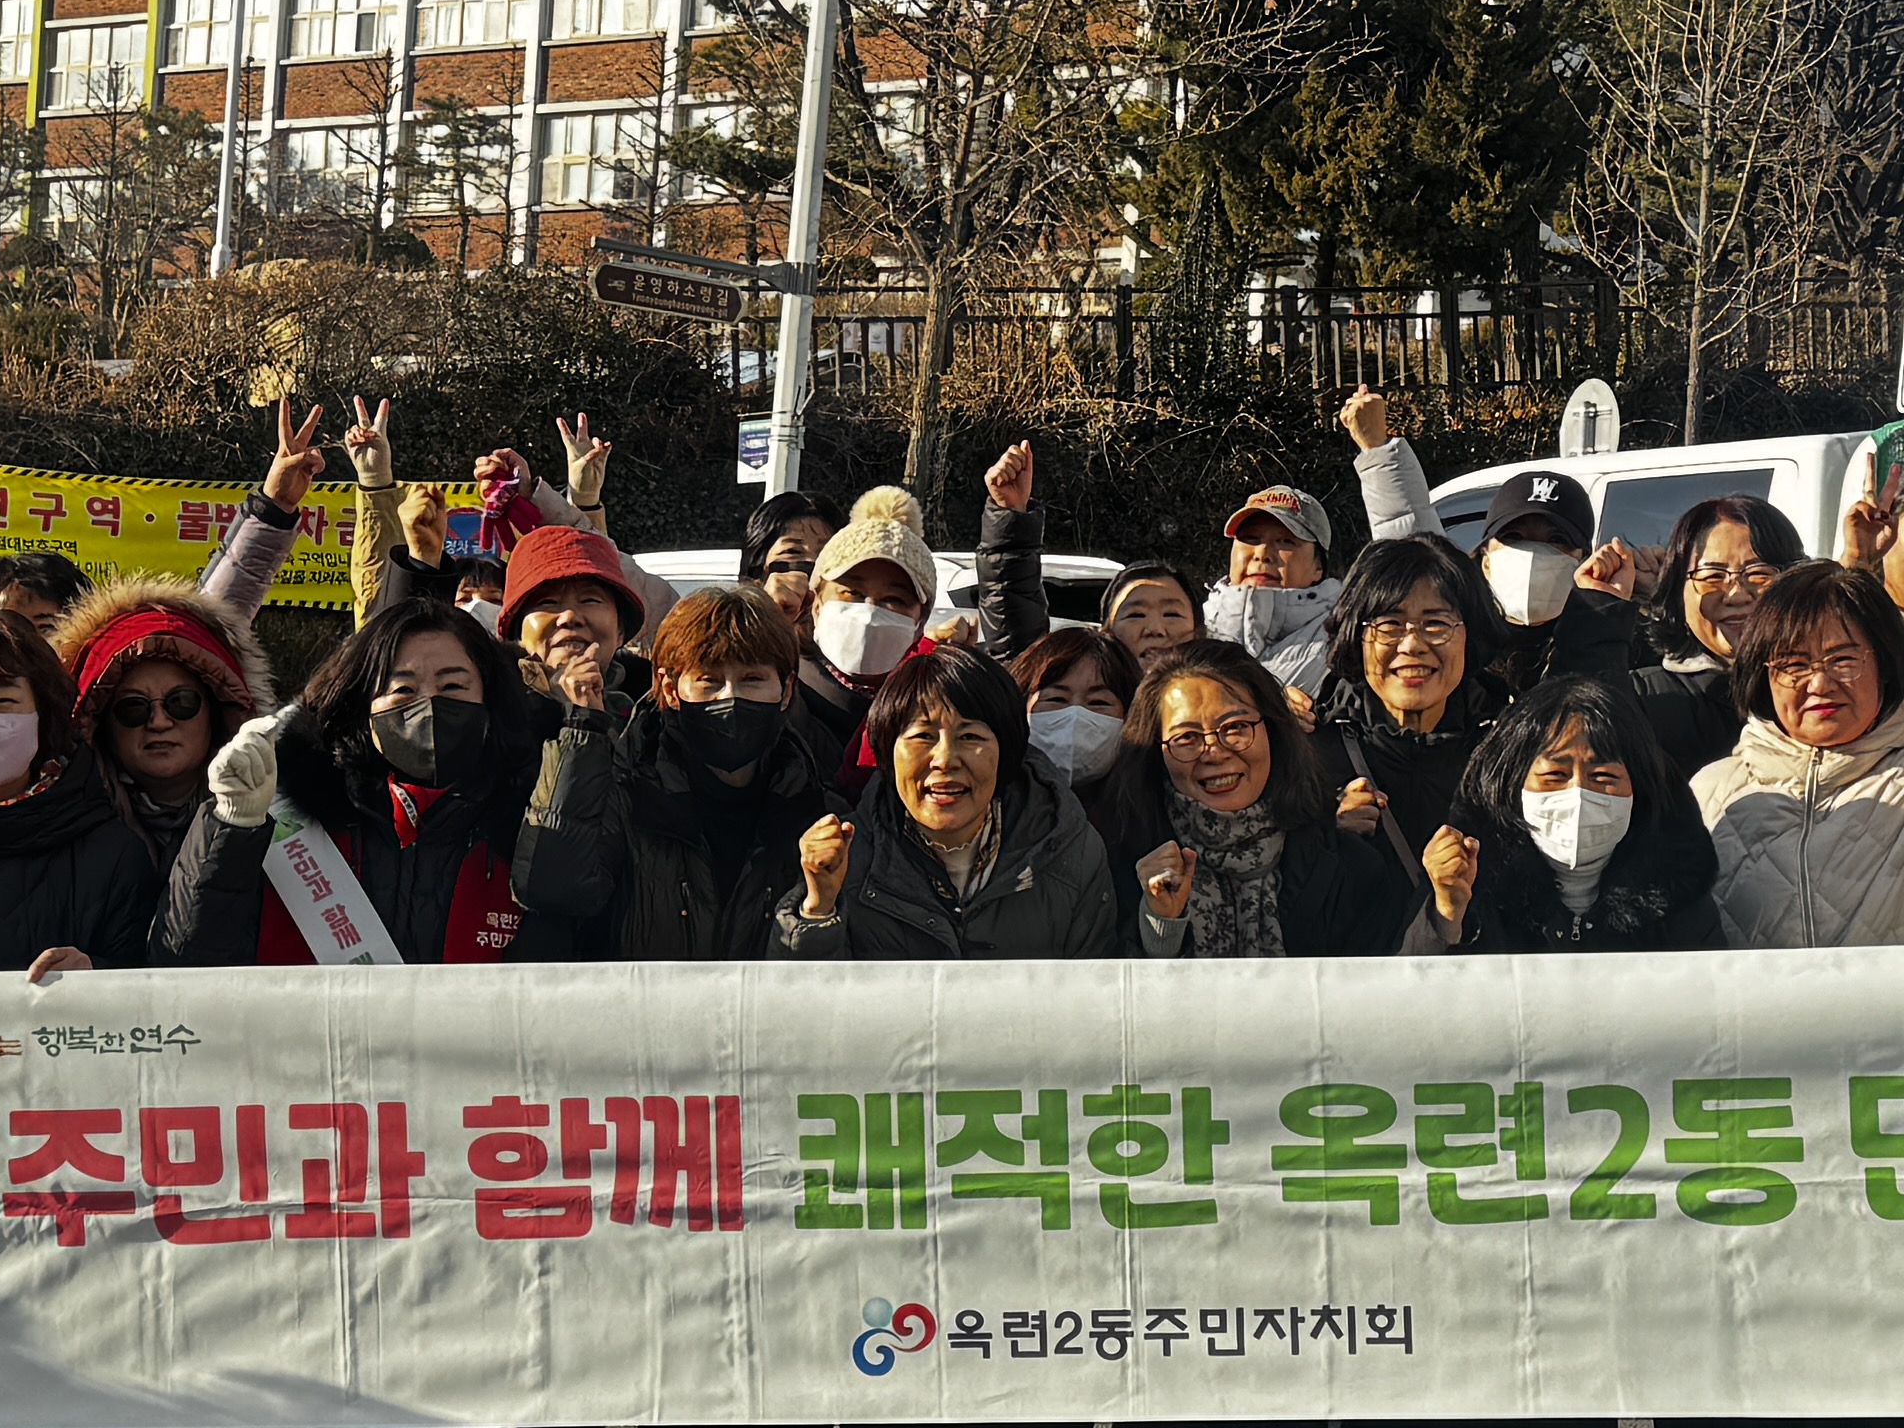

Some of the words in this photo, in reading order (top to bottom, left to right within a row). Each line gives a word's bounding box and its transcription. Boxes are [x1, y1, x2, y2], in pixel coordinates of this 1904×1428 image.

[633, 274, 729, 307] 윤영하소령길
[283, 837, 335, 904] 주민과
[320, 902, 363, 951] 함께
[2, 1101, 426, 1248] 주민과
[462, 1094, 745, 1241] 함께
[794, 1083, 1230, 1231] 쾌적한
[1270, 1076, 1805, 1227] 옥련2동
[946, 1304, 1415, 1361] 옥련2동주민자치회
